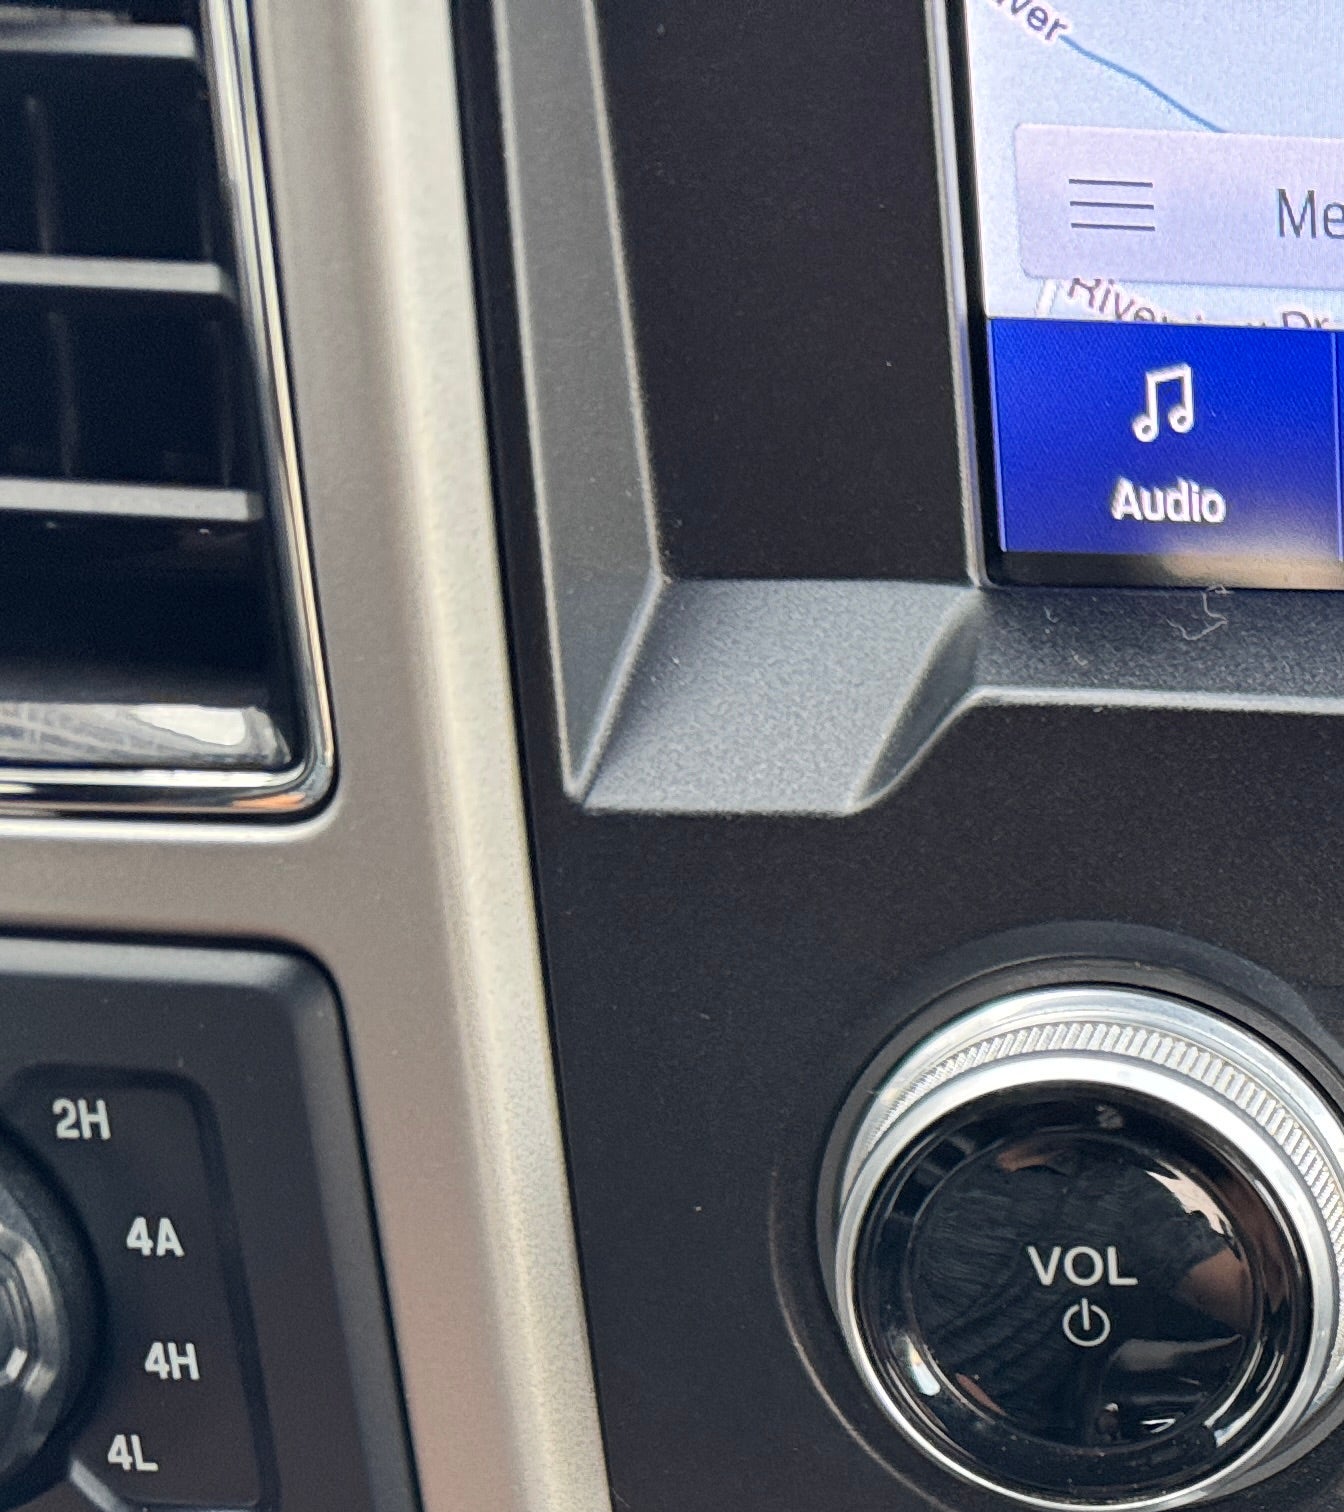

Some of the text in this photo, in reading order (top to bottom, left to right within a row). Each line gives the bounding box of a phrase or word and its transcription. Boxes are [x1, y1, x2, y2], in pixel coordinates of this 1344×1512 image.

[993, 0, 1067, 40] ver
[1111, 477, 1227, 524] Audio
[52, 1098, 112, 1140] 2H
[126, 1217, 185, 1257] 4A
[1027, 1246, 1138, 1286] VOL
[144, 1341, 200, 1381] 4H
[107, 1434, 158, 1472] 4L
